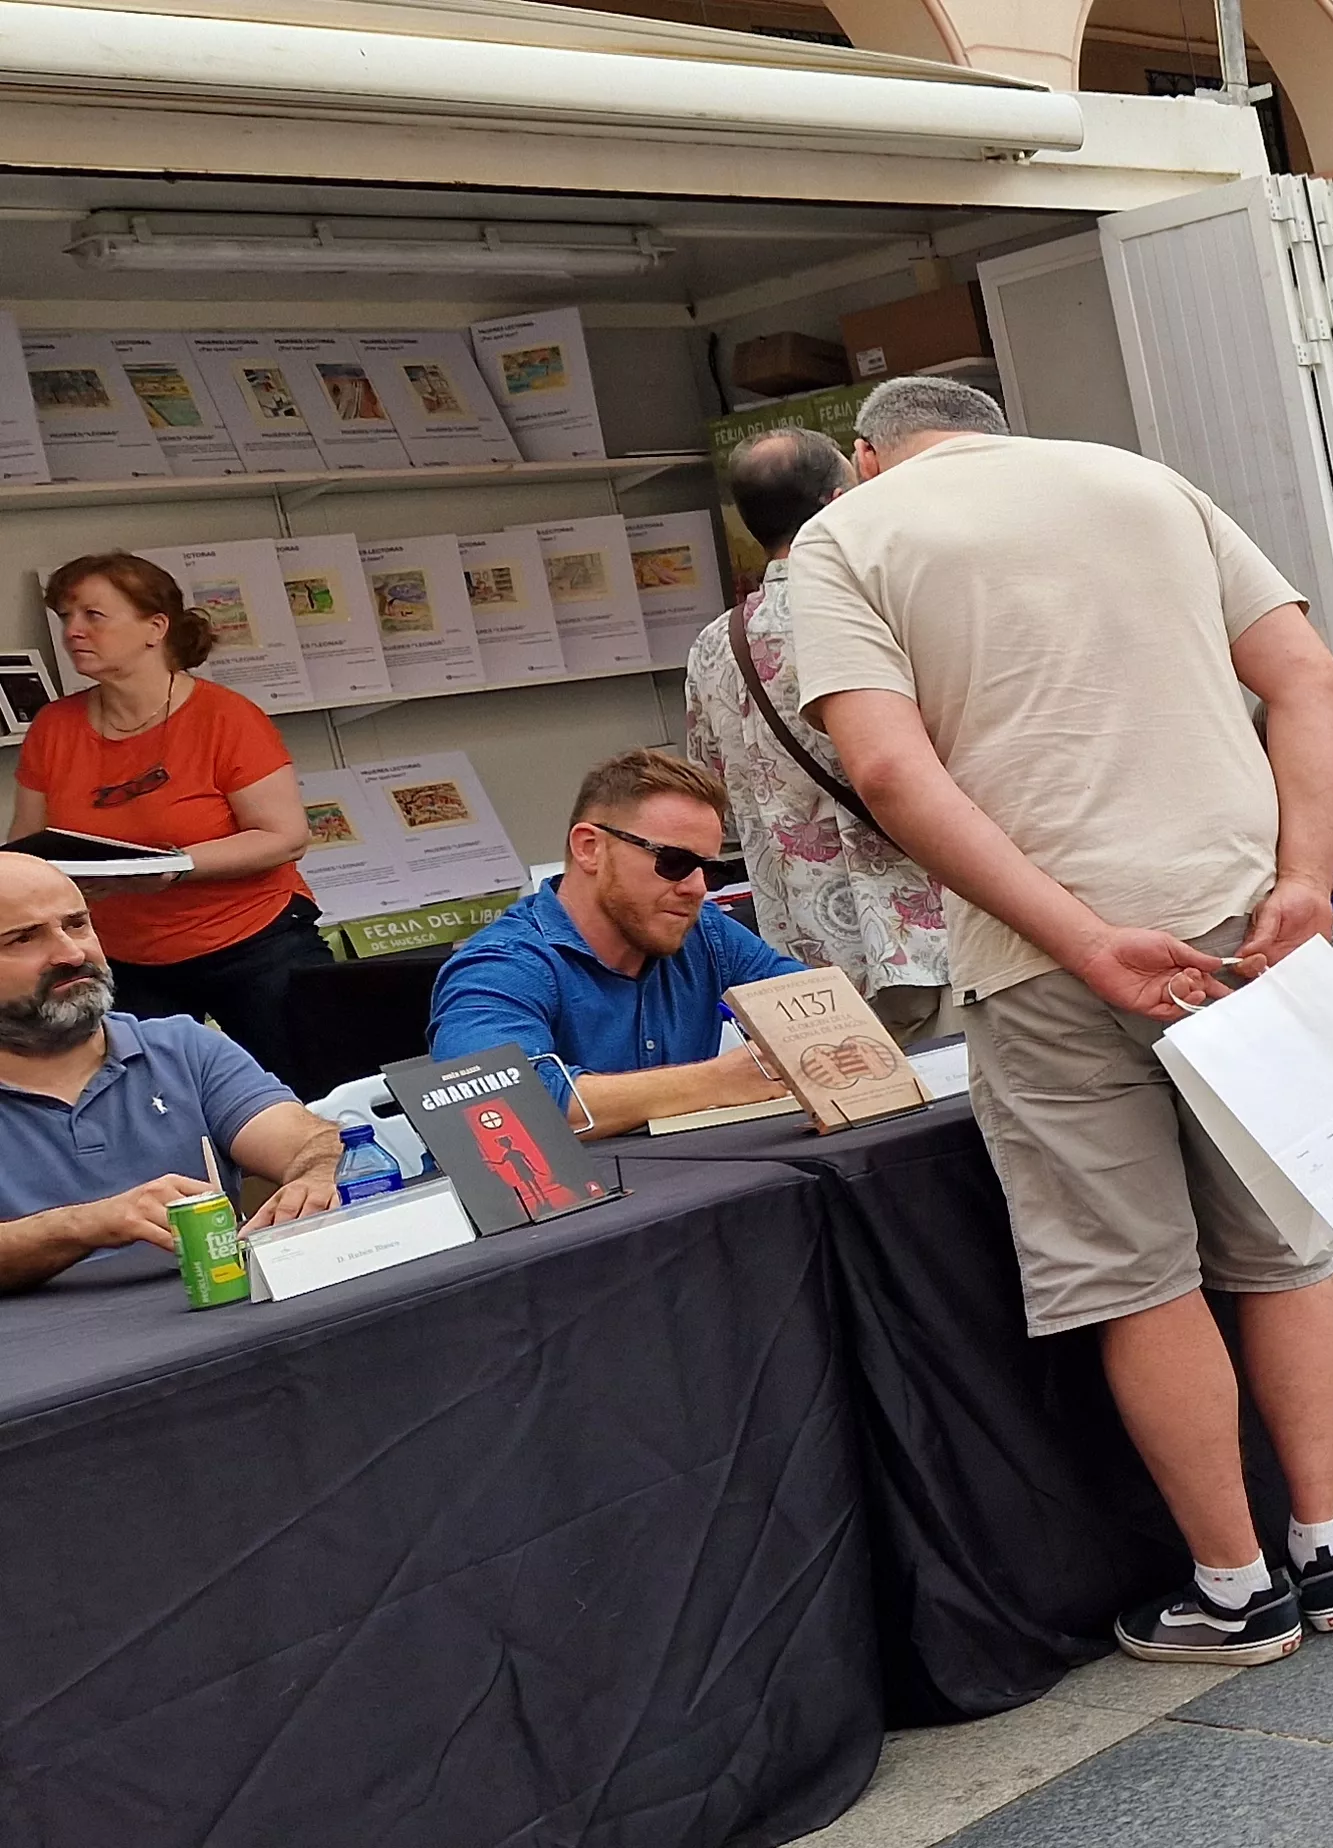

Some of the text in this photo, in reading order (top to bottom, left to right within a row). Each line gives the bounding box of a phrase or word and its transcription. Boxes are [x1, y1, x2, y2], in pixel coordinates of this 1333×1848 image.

[714, 426, 745, 446] FERIA
[363, 919, 423, 940] FERIA
[427, 911, 465, 929] DEL
[371, 932, 438, 951] DE HUESCA
[775, 989, 836, 1022] 1137
[422, 1067, 521, 1111] ¿MARTINA?
[208, 1243, 238, 1260] tea
